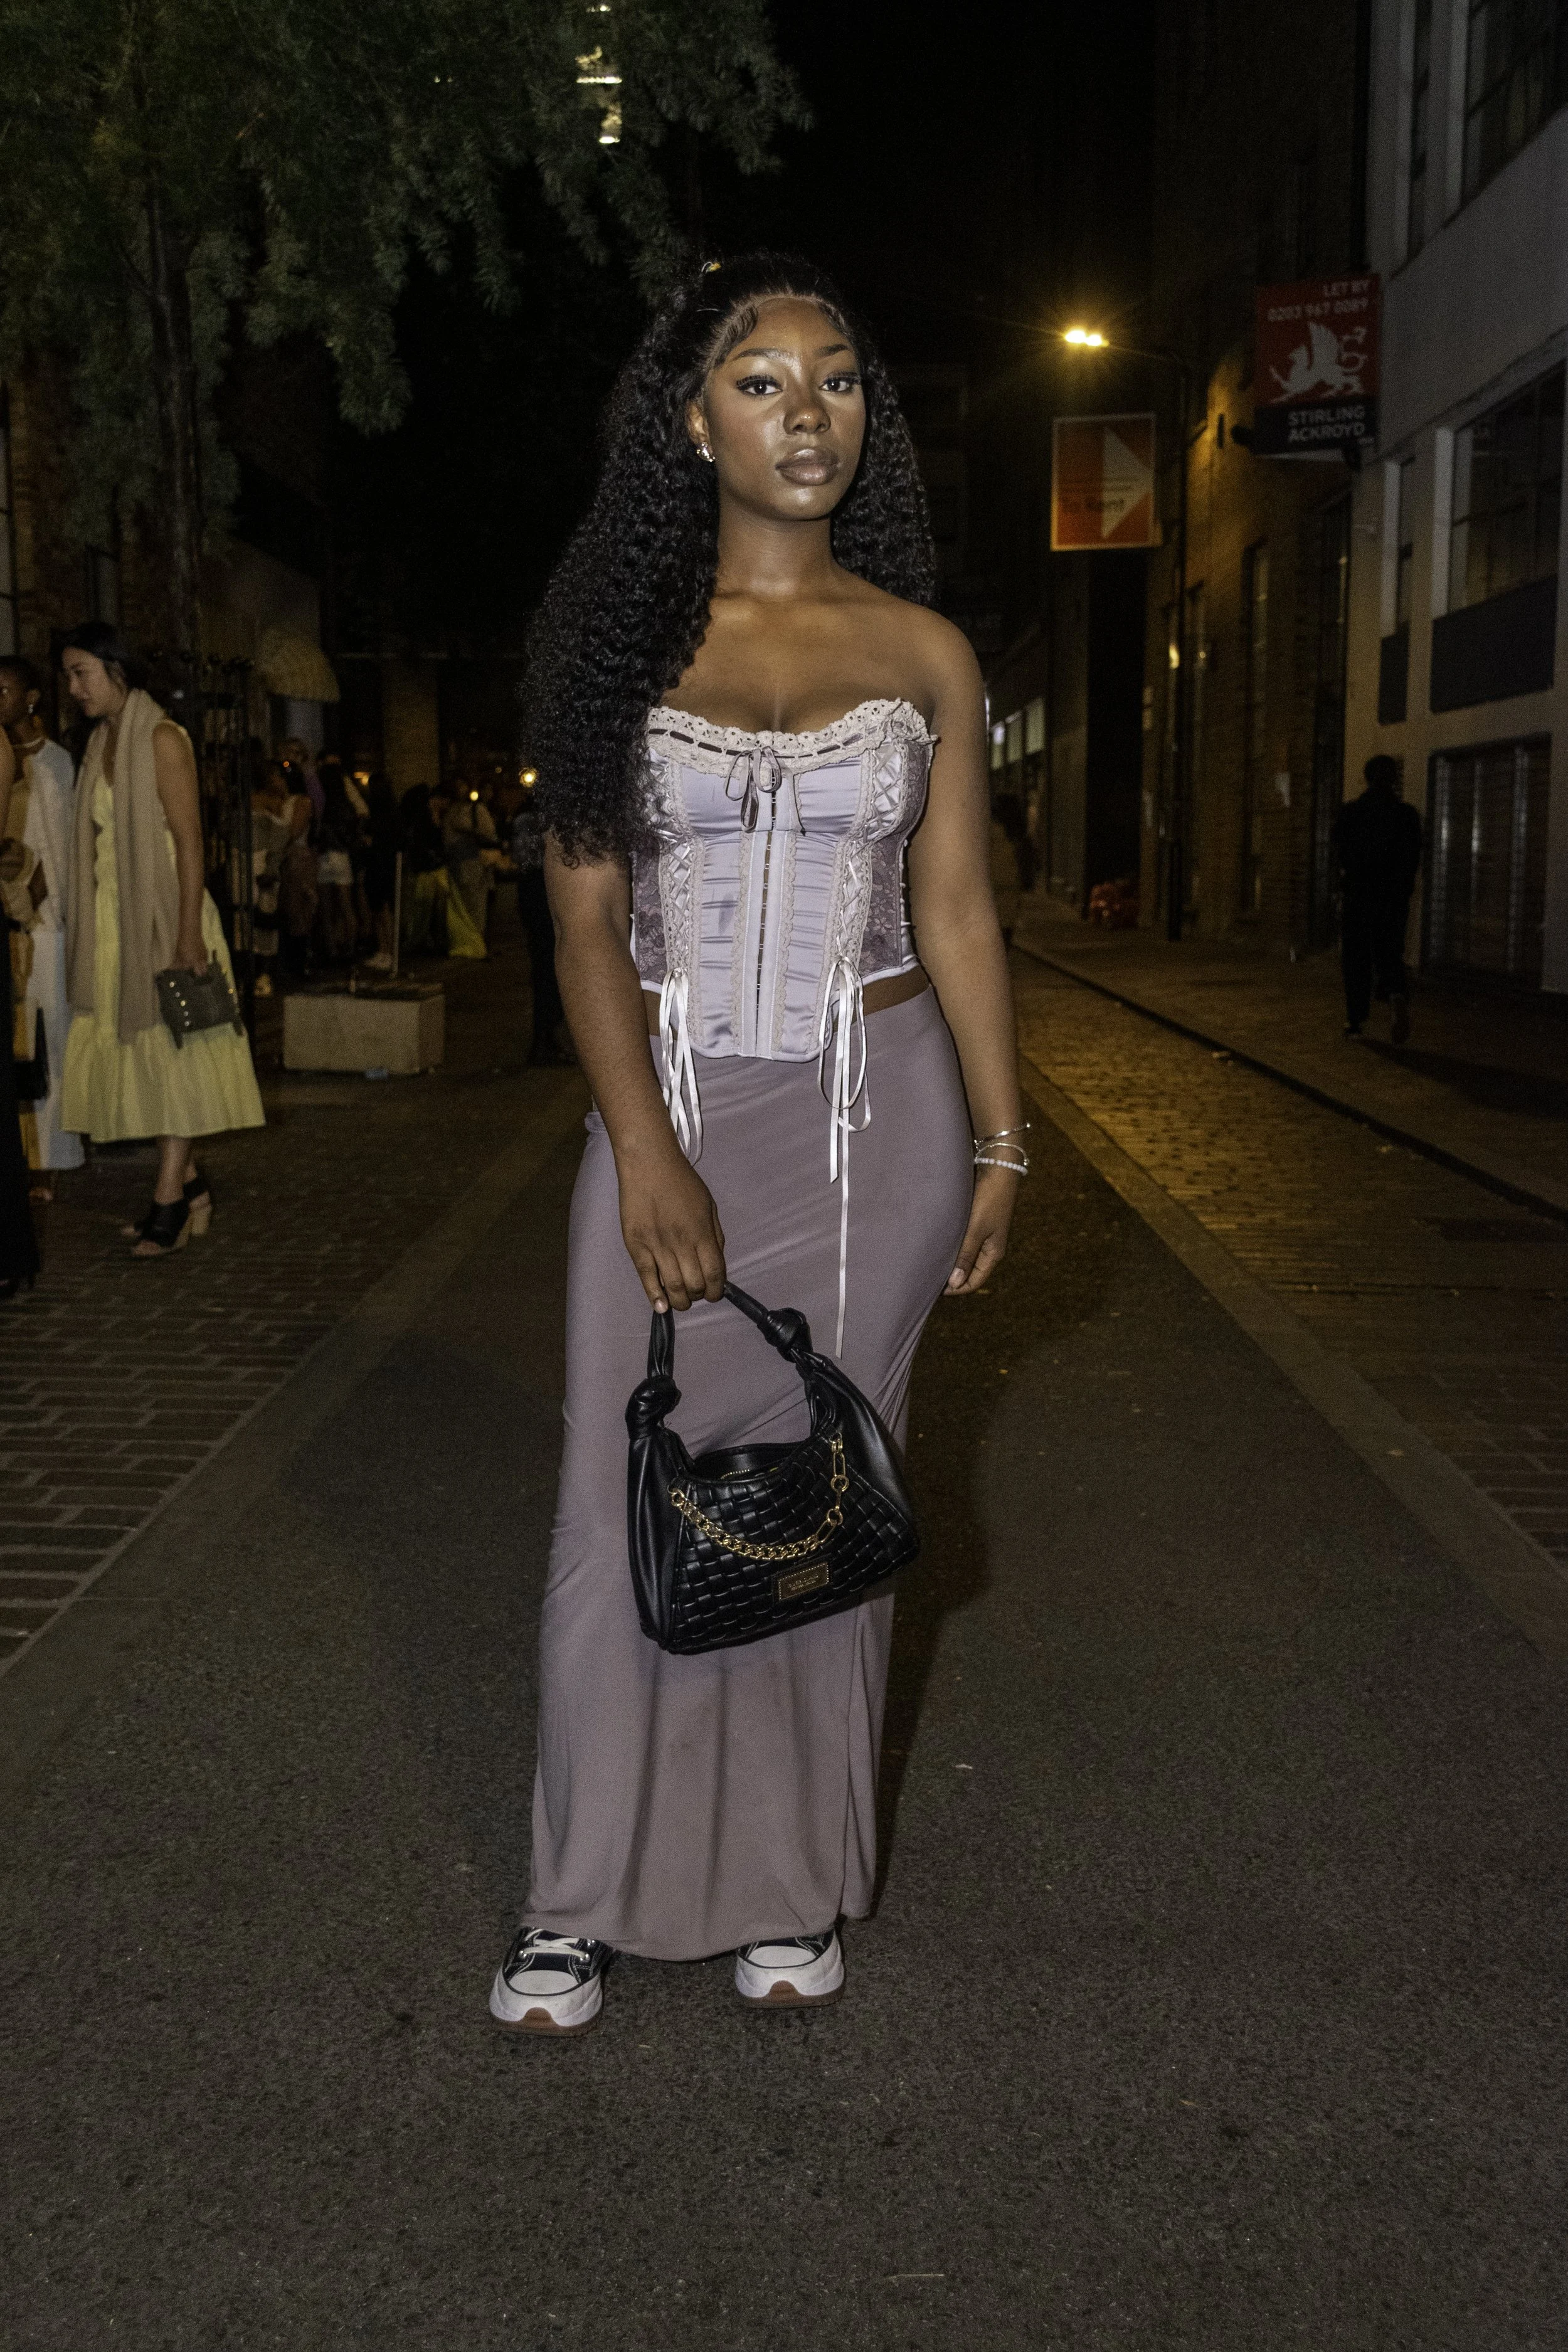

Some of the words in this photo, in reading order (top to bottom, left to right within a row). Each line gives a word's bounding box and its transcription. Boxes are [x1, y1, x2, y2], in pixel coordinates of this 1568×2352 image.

[1323, 282, 1348, 297] LET
[1351, 280, 1370, 294] BY
[1288, 405, 1365, 426] STIRLING
[1288, 422, 1365, 443] ACKROYD
